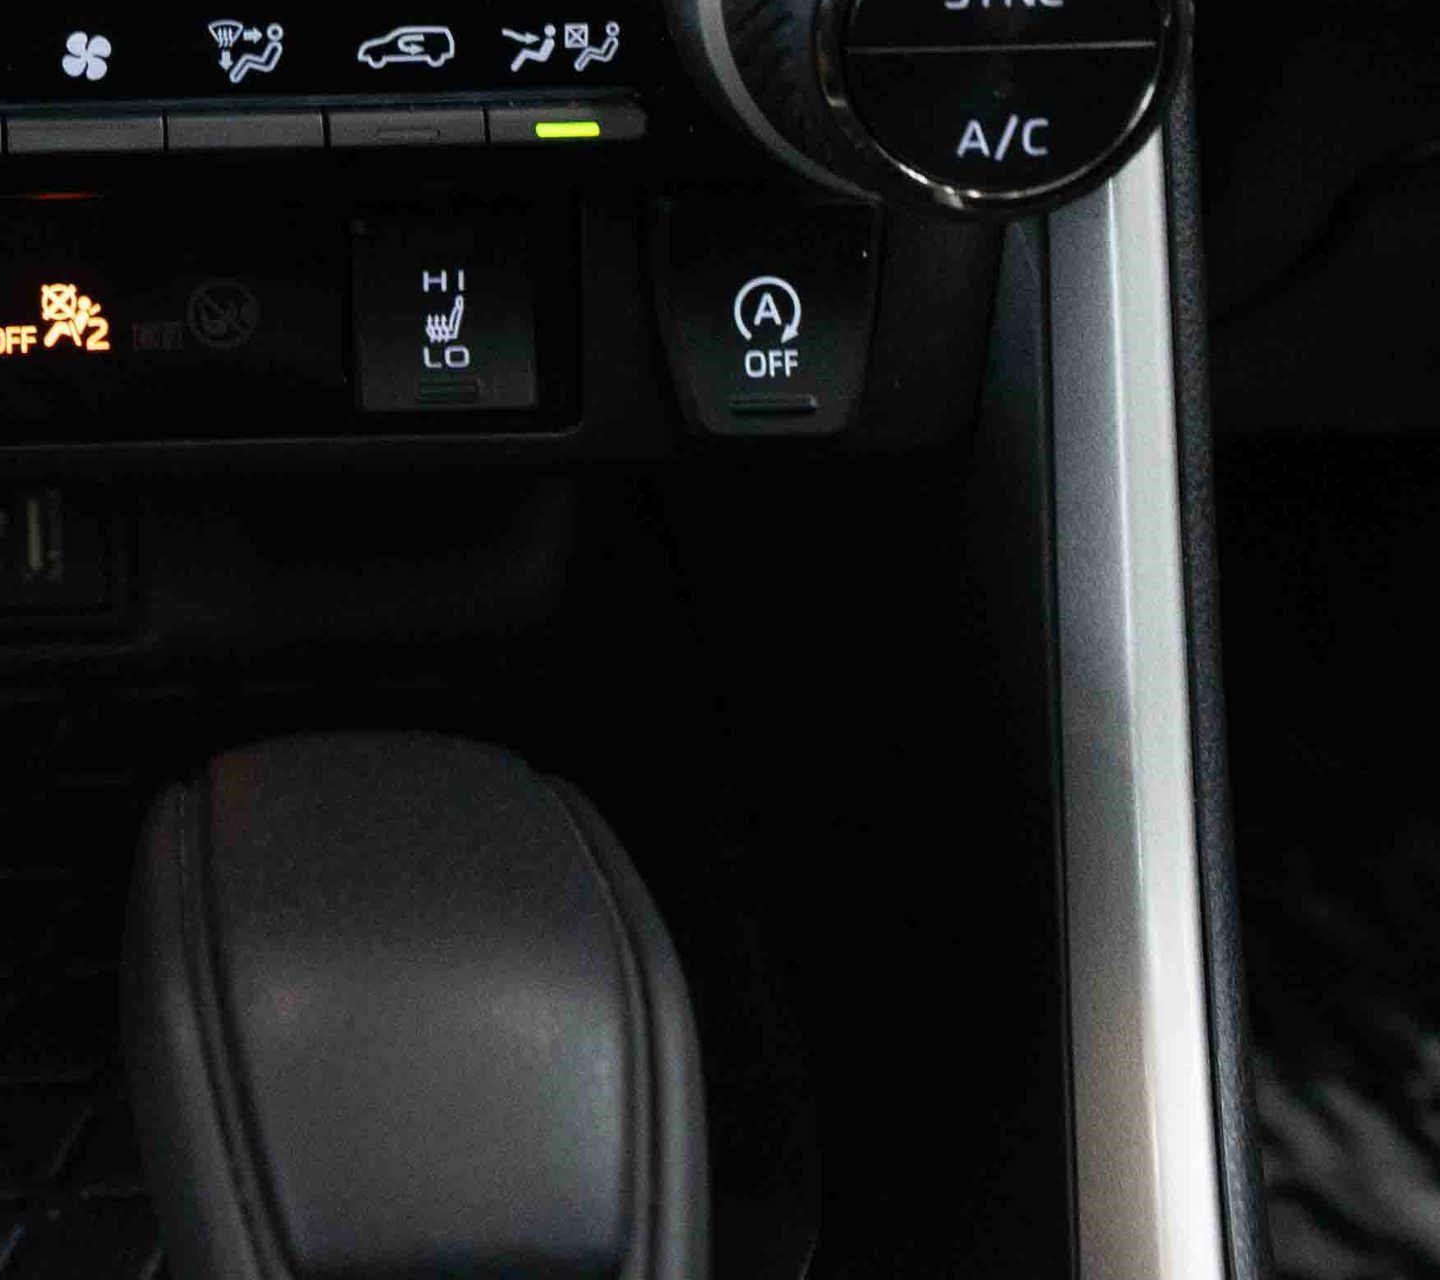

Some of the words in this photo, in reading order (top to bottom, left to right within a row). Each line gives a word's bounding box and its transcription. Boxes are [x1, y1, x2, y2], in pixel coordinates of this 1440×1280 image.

[957, 114, 1049, 161] A/C
[422, 270, 465, 293] HI
[423, 345, 470, 369] LO
[744, 349, 799, 378] OFF
